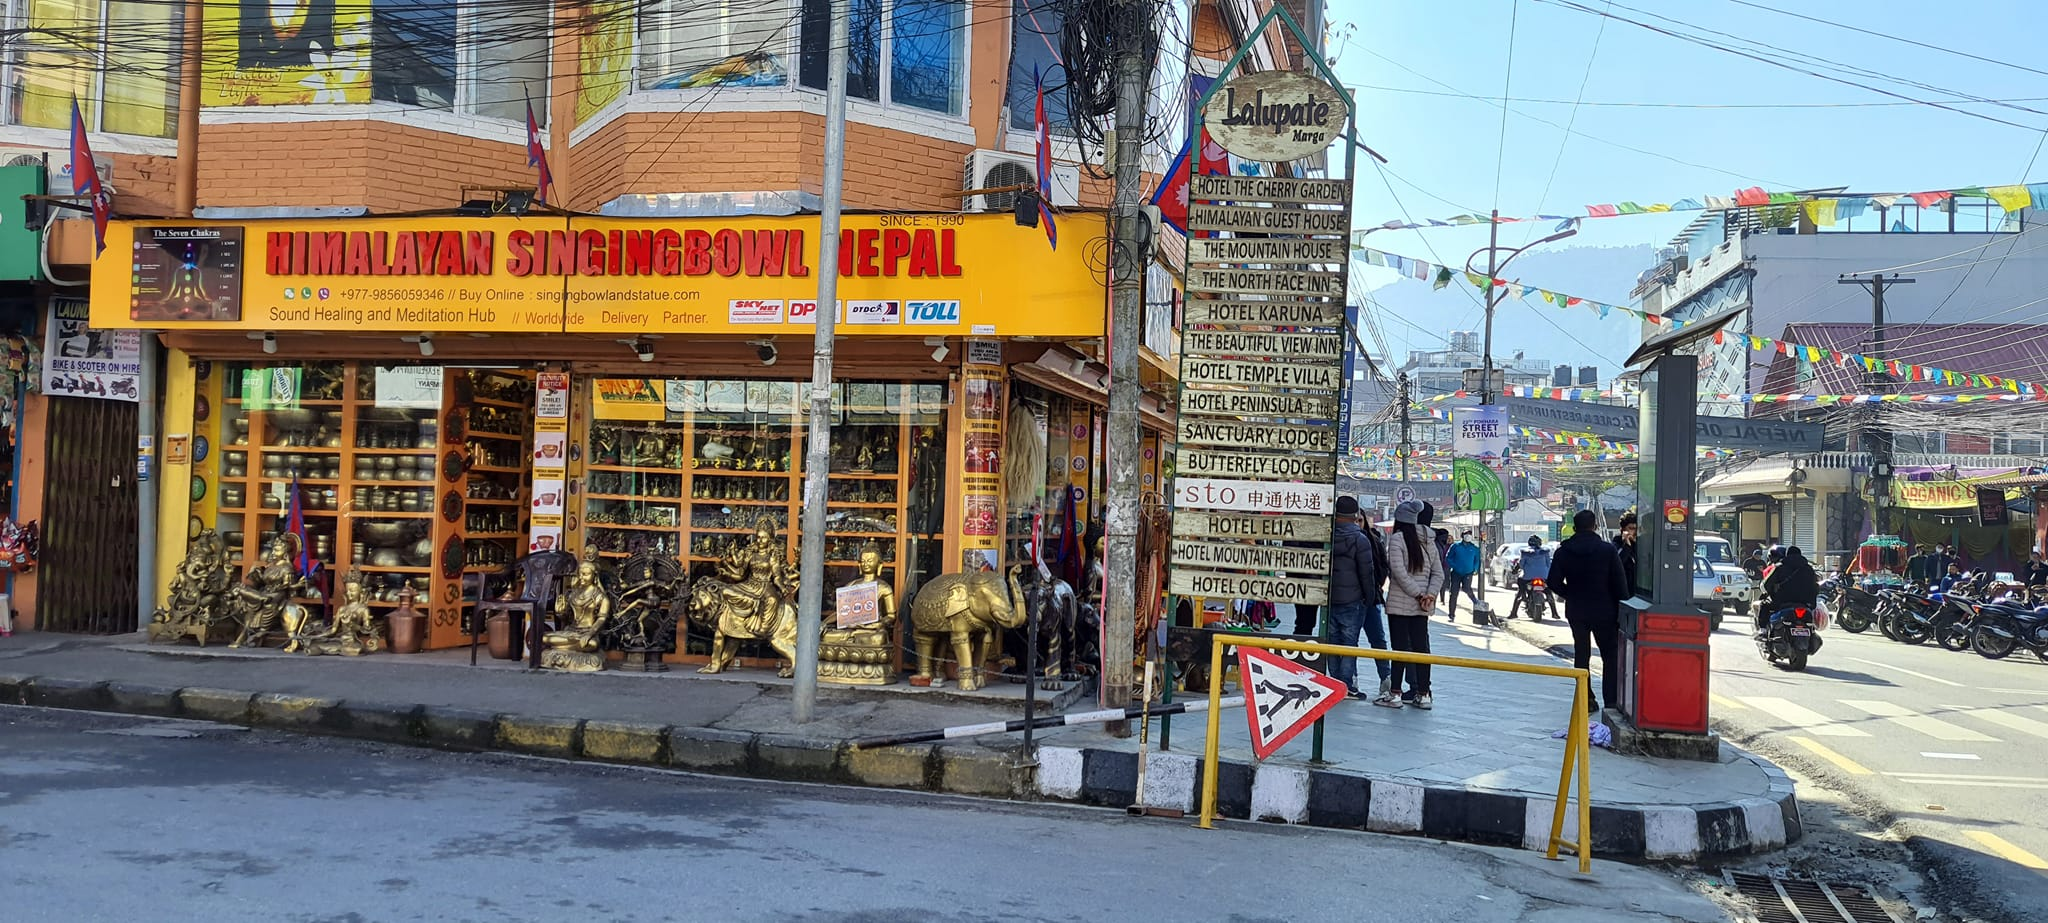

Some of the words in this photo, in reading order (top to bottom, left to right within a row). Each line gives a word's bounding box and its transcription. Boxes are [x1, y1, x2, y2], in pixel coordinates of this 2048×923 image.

[1221, 87, 1329, 134] Lalupate
[1292, 129, 1325, 144] Marga
[1198, 178, 1231, 196] HOTEL
[1234, 180, 1253, 196] THE
[1256, 182, 1298, 198] CHERRY
[1300, 183, 1345, 200] GARDEN
[880, 215, 922, 227] SINCE
[935, 214, 964, 226] 1990
[1194, 209, 1263, 226] HIMALAYAN
[1264, 211, 1301, 229] GUEST
[1303, 213, 1343, 231] HOUSE
[154, 229, 167, 237] The
[168, 229, 189, 237] Seven
[190, 228, 220, 237] Chakras
[265, 230, 495, 276] HIMALAYAN
[506, 228, 809, 277] SINGINGBOWL
[837, 228, 962, 277] NEPAL
[1203, 242, 1226, 258] THE
[1227, 242, 1290, 259] MOUNTAIN
[1293, 243, 1332, 259] HOUSE
[1202, 271, 1225, 288] THE
[1228, 273, 1271, 290] NORTH
[1275, 275, 1304, 291] FACE
[1307, 276, 1331, 292] INN
[339, 288, 444, 300] +977-9856059346
[459, 289, 482, 302] Buy
[485, 288, 525, 300] Online
[536, 290, 700, 303] singingbowlandstatue.com
[269, 306, 310, 322] Sound
[314, 307, 363, 325] Healing
[366, 306, 391, 321] and
[396, 307, 464, 322] Meditation
[468, 307, 496, 322] Hub
[524, 311, 585, 325] Worldwide
[601, 311, 649, 327] Delivery
[663, 311, 709, 325] Partner.
[907, 302, 958, 320] TOLL
[1208, 303, 1254, 321] HOTEL
[1259, 305, 1323, 322] KARUNA
[1190, 333, 1212, 349] THE
[1215, 333, 1278, 352] BEAUTIFUL
[1281, 336, 1312, 354] VIEW
[1315, 337, 1337, 354] INN
[52, 359, 69, 369] BIKE
[70, 361, 75, 370] &
[77, 360, 106, 372] SCOTER
[108, 362, 120, 372] ON
[121, 363, 140, 374] HIRE
[1189, 362, 1232, 380] HOTEL
[1236, 364, 1289, 383] TEMPLE
[1293, 367, 1330, 385] VILLA
[1188, 393, 1228, 411] HOTEL
[1231, 395, 1302, 414] PENINSULA
[1185, 423, 1274, 443] SANCTUARY
[1278, 428, 1328, 447] LODGE
[1462, 423, 1499, 432] STREET
[1462, 431, 1499, 439] FESTIVAL
[1188, 453, 1268, 473] BUTTERFLY
[1272, 457, 1321, 476] LODGE
[1185, 481, 1236, 505] sto
[1248, 489, 1322, 510] 申通快递
[1900, 484, 1961, 503] ORGANIC
[1208, 517, 1257, 535] HOTEL
[1262, 520, 1295, 537] ELIA
[1178, 543, 1211, 561] HOTEL
[1213, 545, 1272, 566] MOUNTAIN
[1275, 551, 1326, 570] HERITAGE
[1192, 575, 1235, 594] HOTEL
[1239, 579, 1307, 599] OCTAGON
